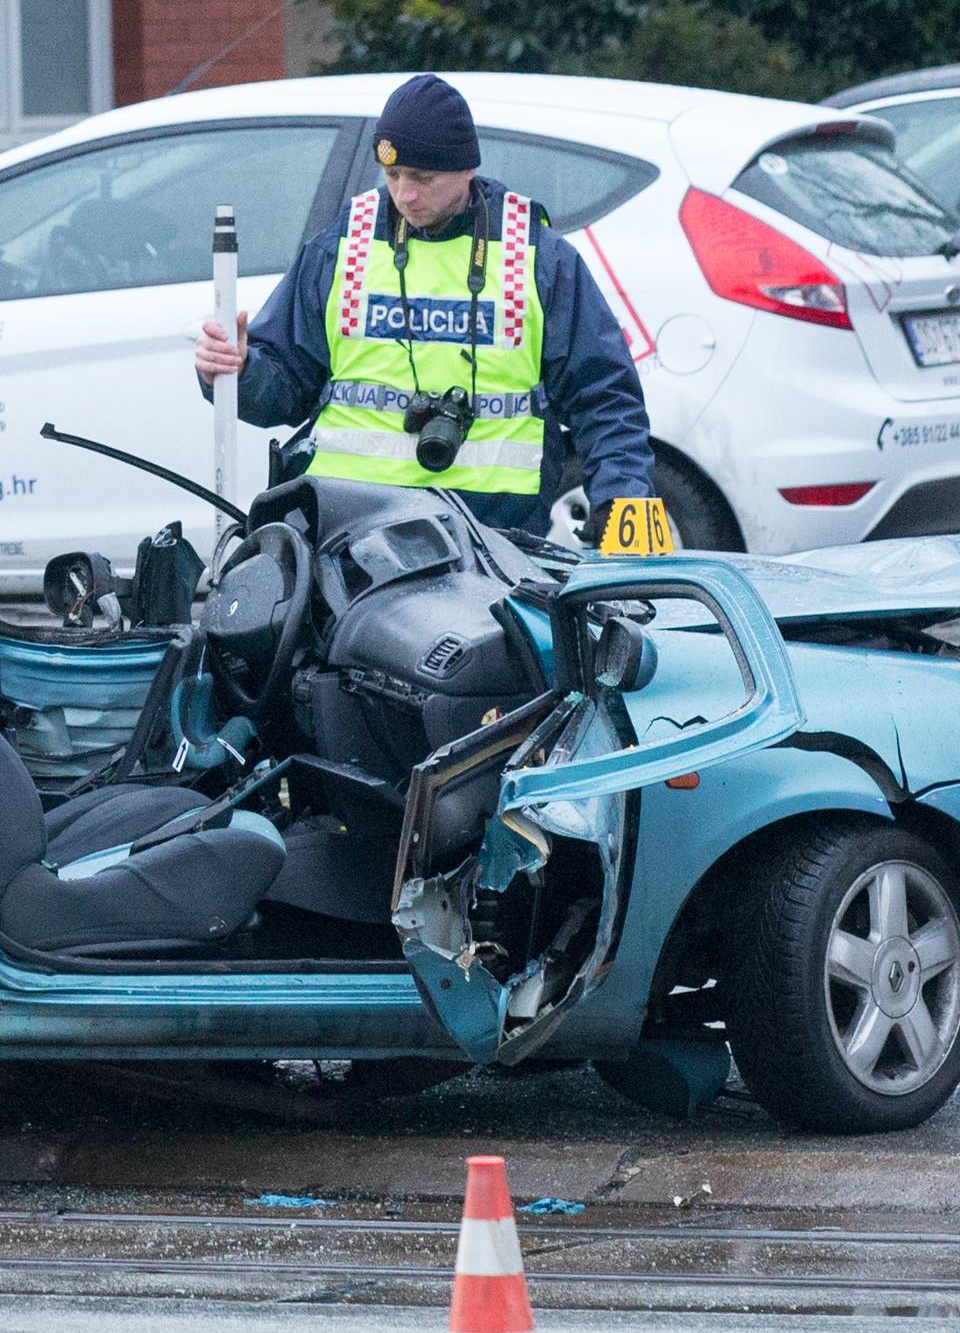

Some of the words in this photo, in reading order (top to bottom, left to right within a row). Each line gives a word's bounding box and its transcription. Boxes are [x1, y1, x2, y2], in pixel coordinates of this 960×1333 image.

[370, 304, 488, 335] POLICIJA
[618, 503, 637, 548] 6
[652, 503, 665, 548] 6
